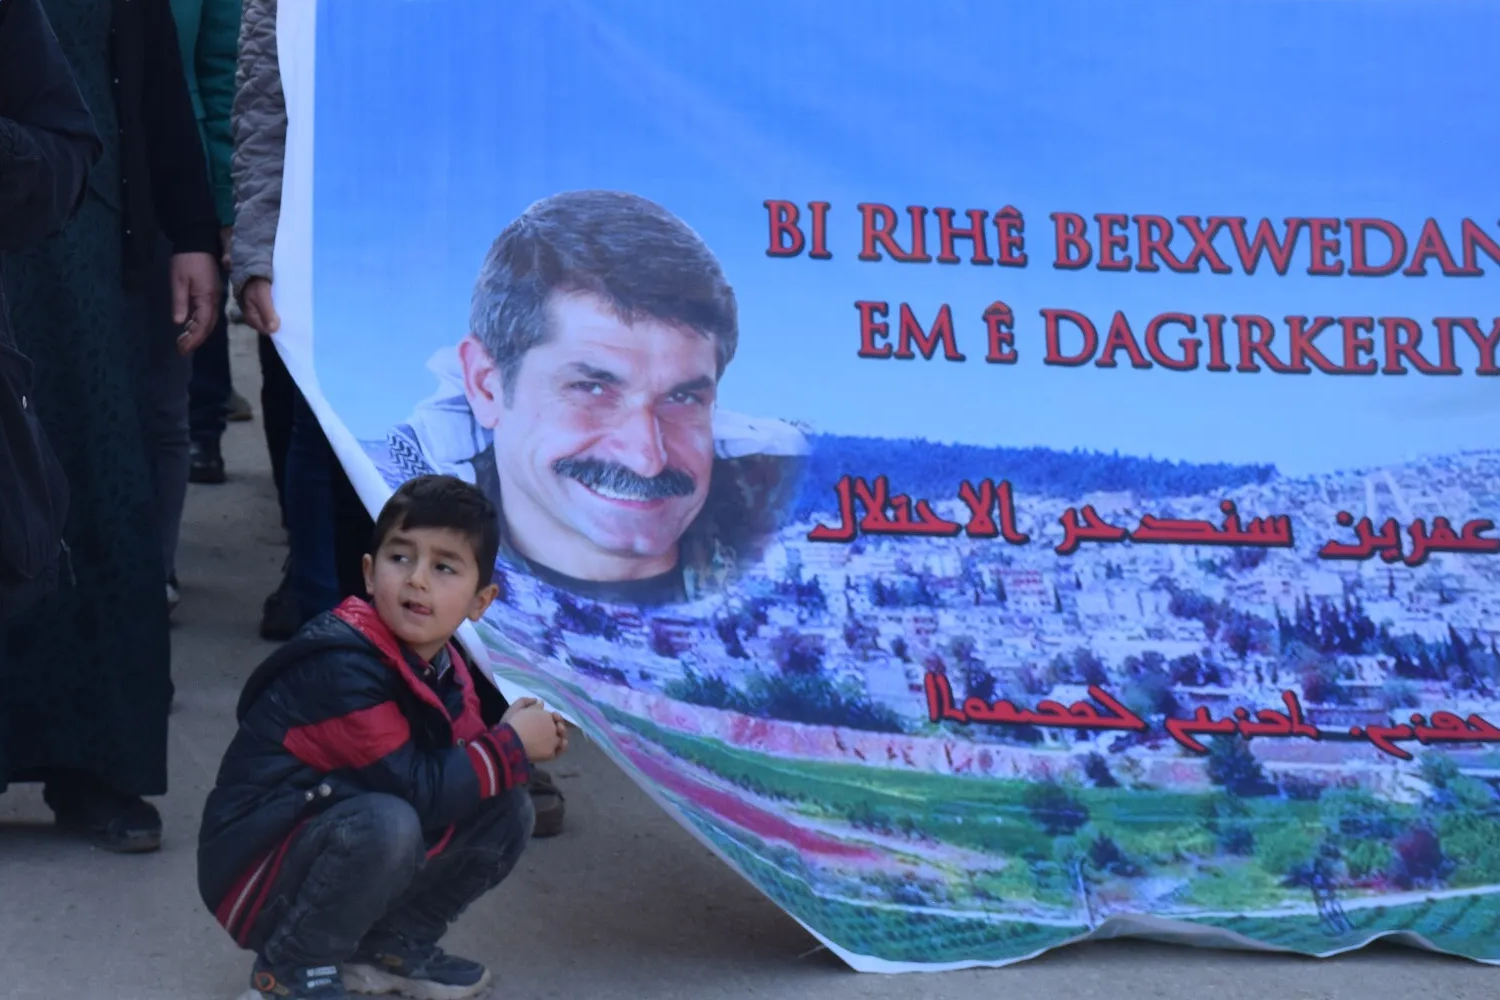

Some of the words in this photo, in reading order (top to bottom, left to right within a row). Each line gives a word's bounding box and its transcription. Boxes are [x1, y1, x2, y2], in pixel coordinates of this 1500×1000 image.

[764, 199, 832, 259] BI
[857, 203, 1027, 267] RIHÊ
[1050, 212, 1500, 277] BERXWEDAN
[854, 301, 966, 362] EM
[982, 300, 1018, 364] Ê
[1040, 308, 1500, 376] DAGIRKERIY
[807, 474, 1030, 543] الاحتلال
[1318, 511, 1500, 567] عفرين
